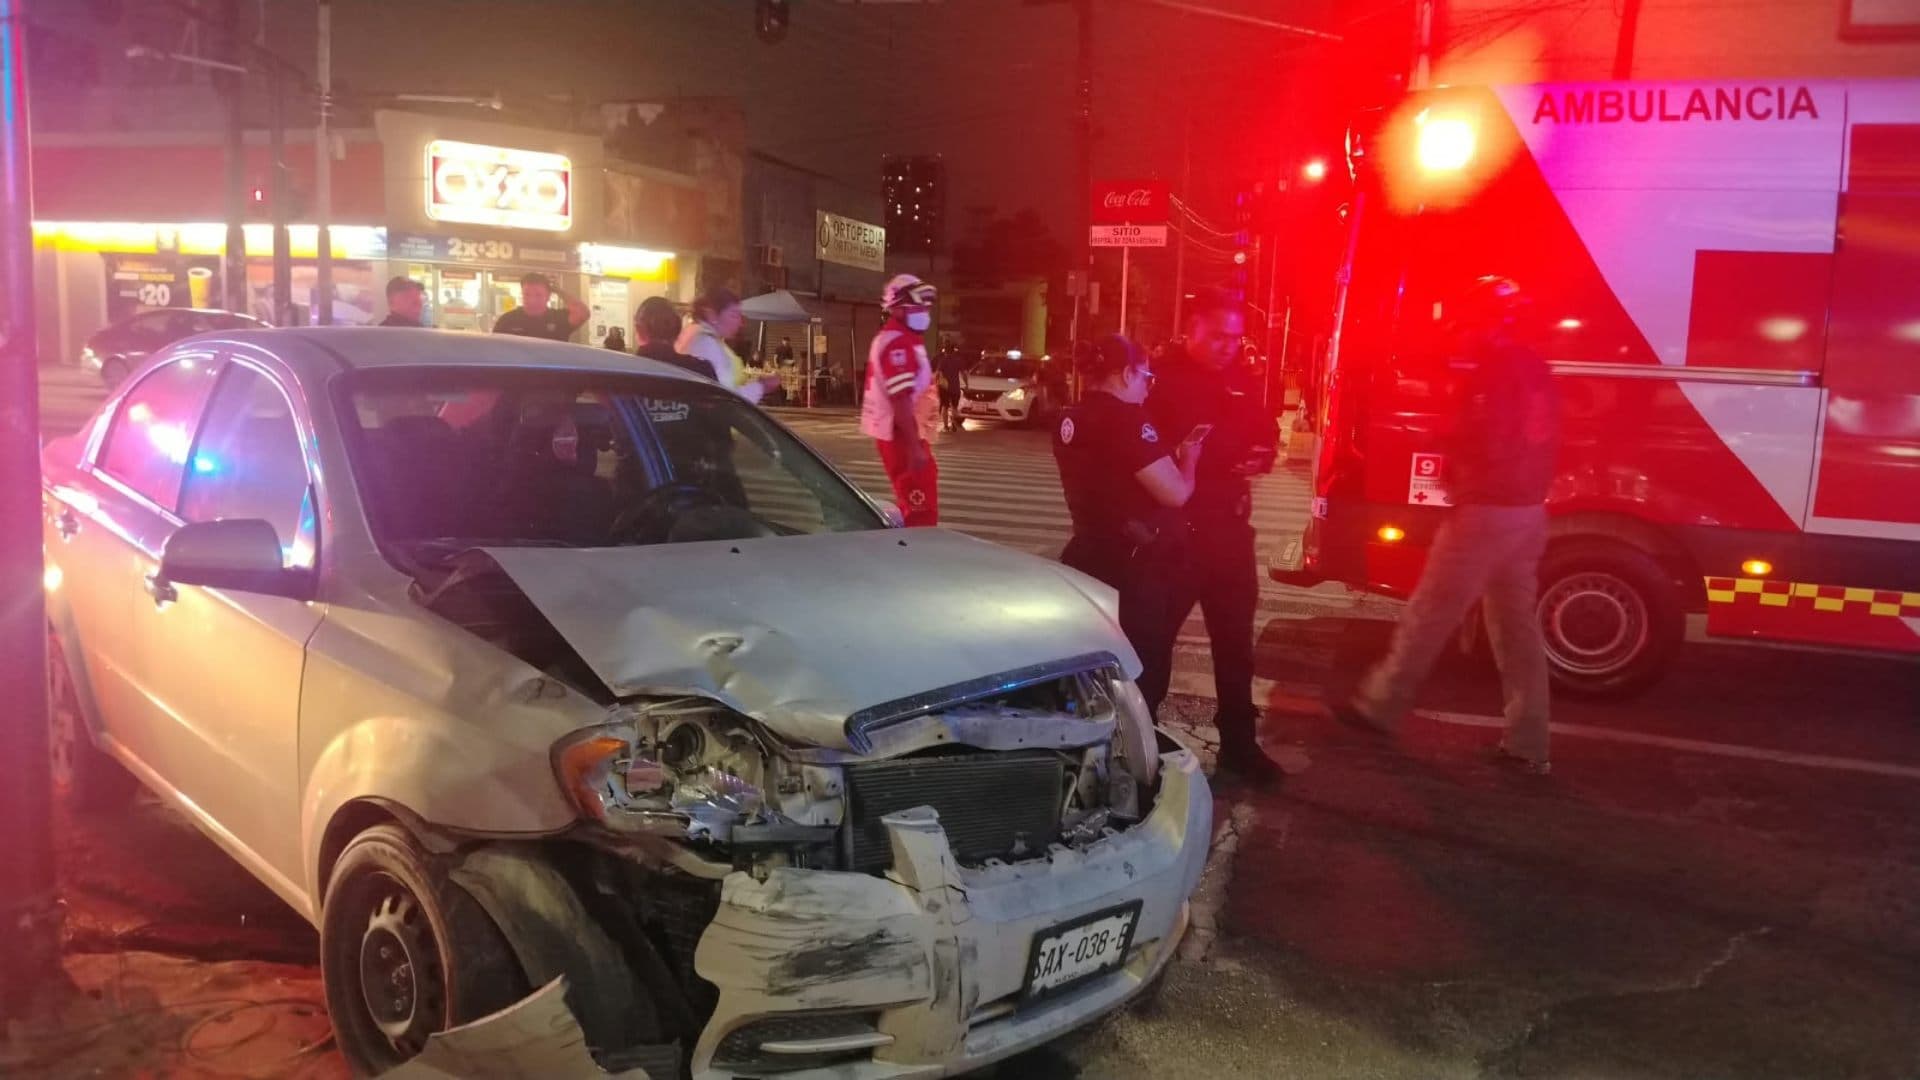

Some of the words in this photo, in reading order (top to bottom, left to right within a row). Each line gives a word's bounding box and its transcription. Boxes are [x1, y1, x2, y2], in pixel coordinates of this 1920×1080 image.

[1532, 86, 1819, 124] AMBULANCIA
[833, 220, 884, 248] ORTOPEDIA
[1112, 227, 1141, 236] SITIO
[139, 283, 170, 306] $20
[1421, 459, 1435, 475] 9
